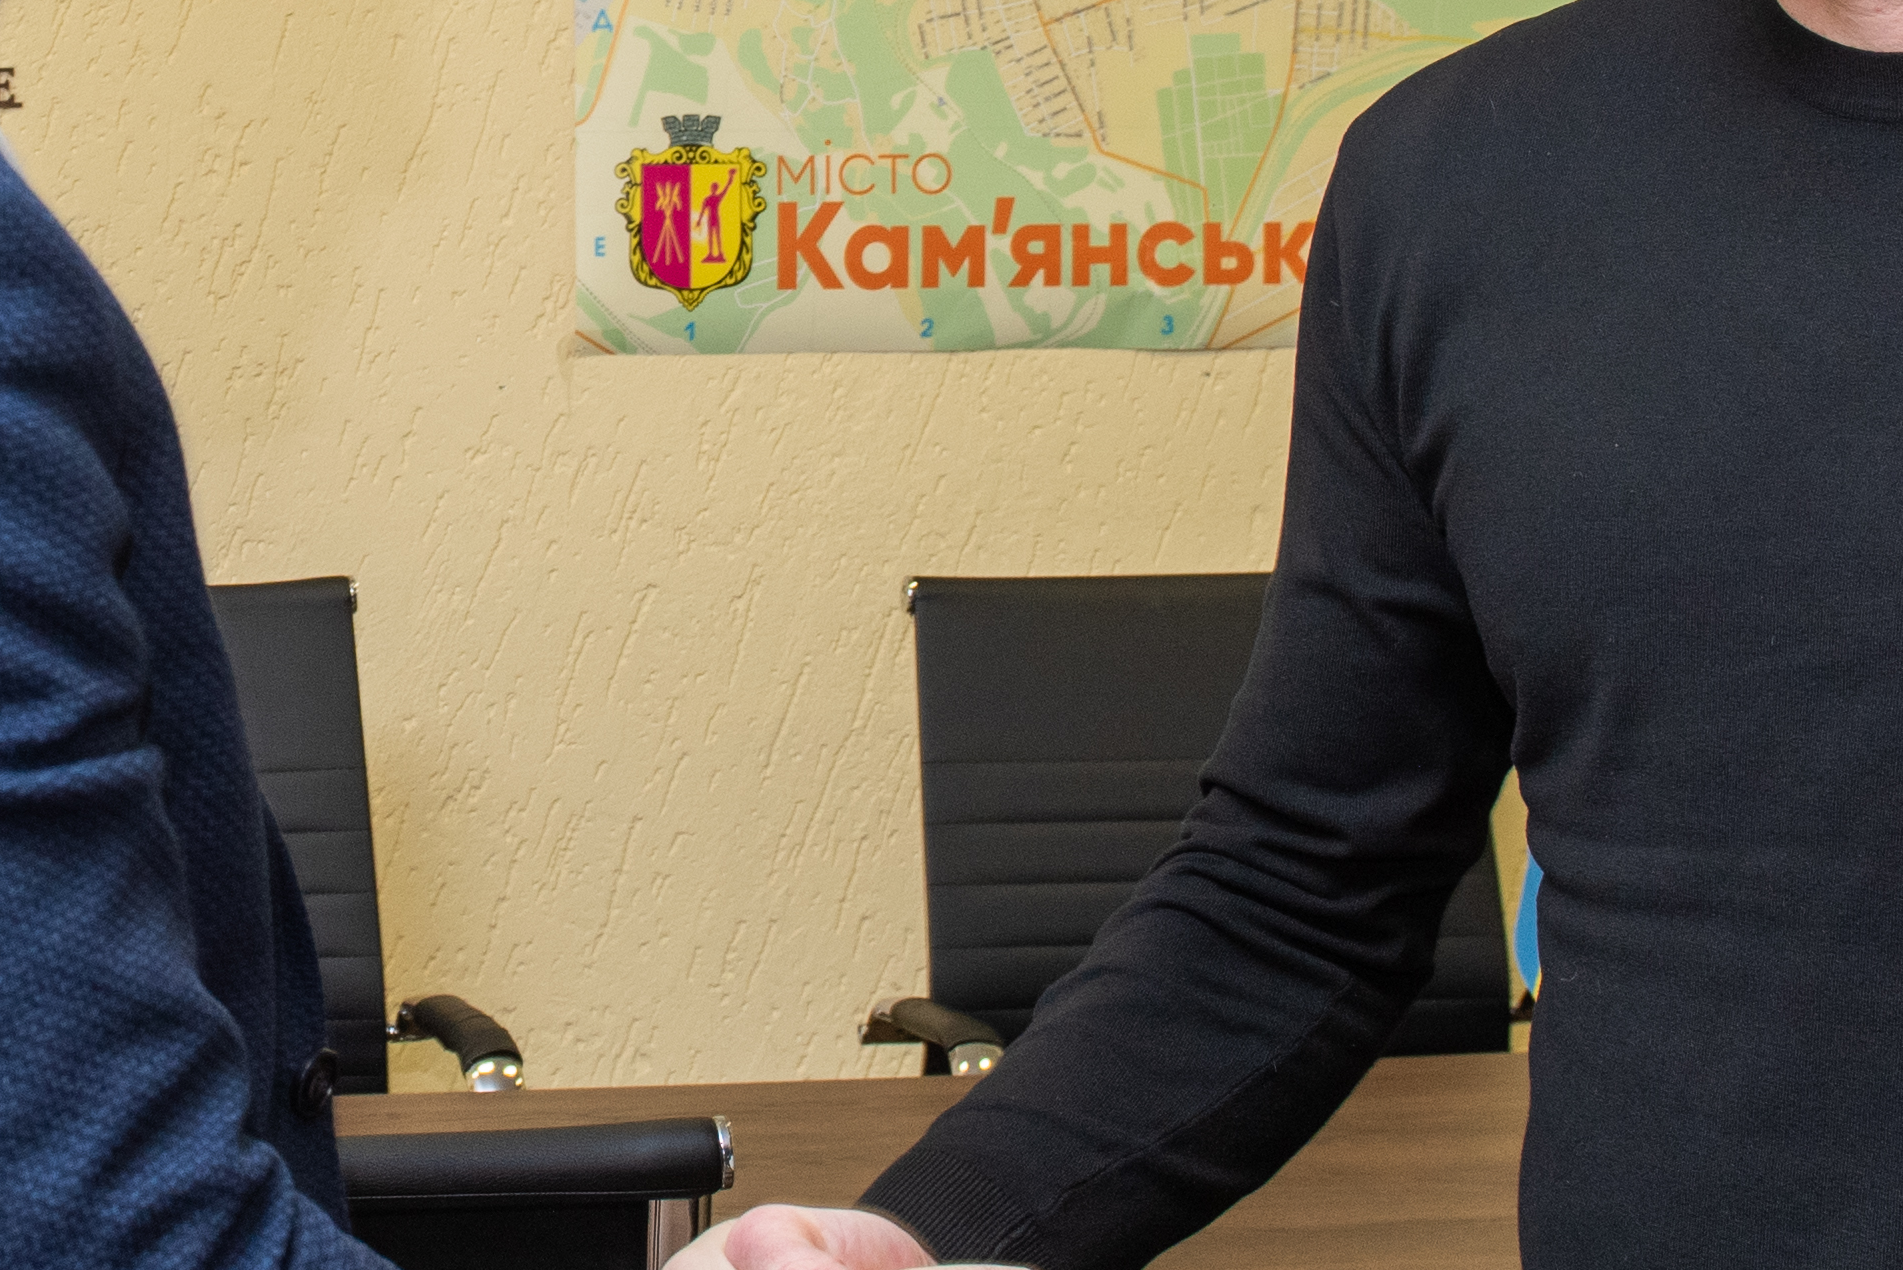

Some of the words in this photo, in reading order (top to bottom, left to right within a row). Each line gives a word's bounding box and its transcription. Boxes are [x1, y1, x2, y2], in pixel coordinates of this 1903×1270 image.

[595, 237, 607, 258] Е
[777, 197, 1316, 290] Кам'янськ
[685, 321, 696, 341] 1
[920, 318, 934, 339] 2
[1160, 314, 1175, 335] 3
